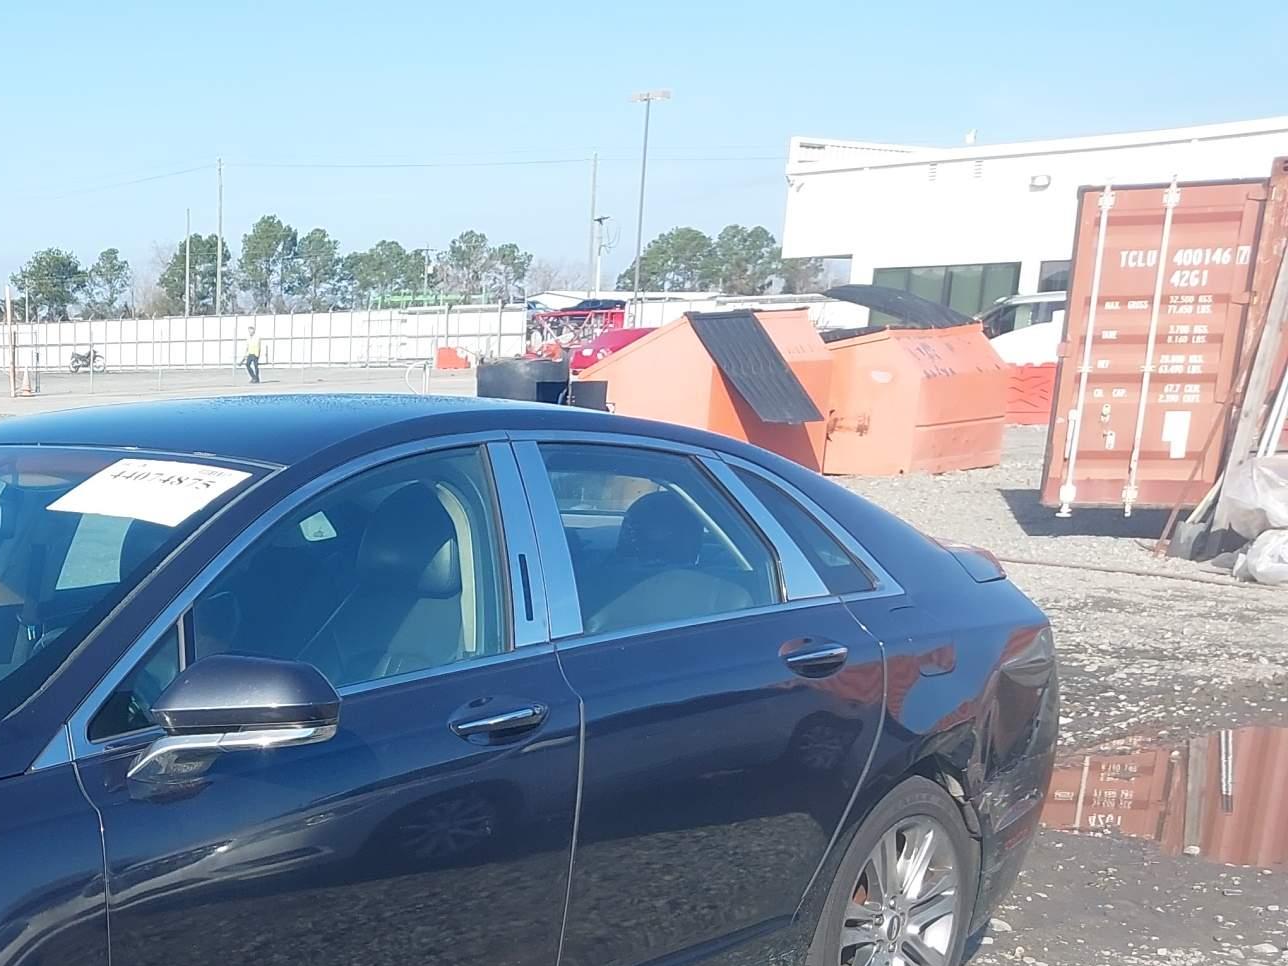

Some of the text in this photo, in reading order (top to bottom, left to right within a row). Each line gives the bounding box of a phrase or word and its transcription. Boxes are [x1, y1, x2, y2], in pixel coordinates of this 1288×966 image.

[1120, 250, 1159, 267] TCLU
[1173, 248, 1232, 266] 400146
[110, 470, 216, 489] 44074875
